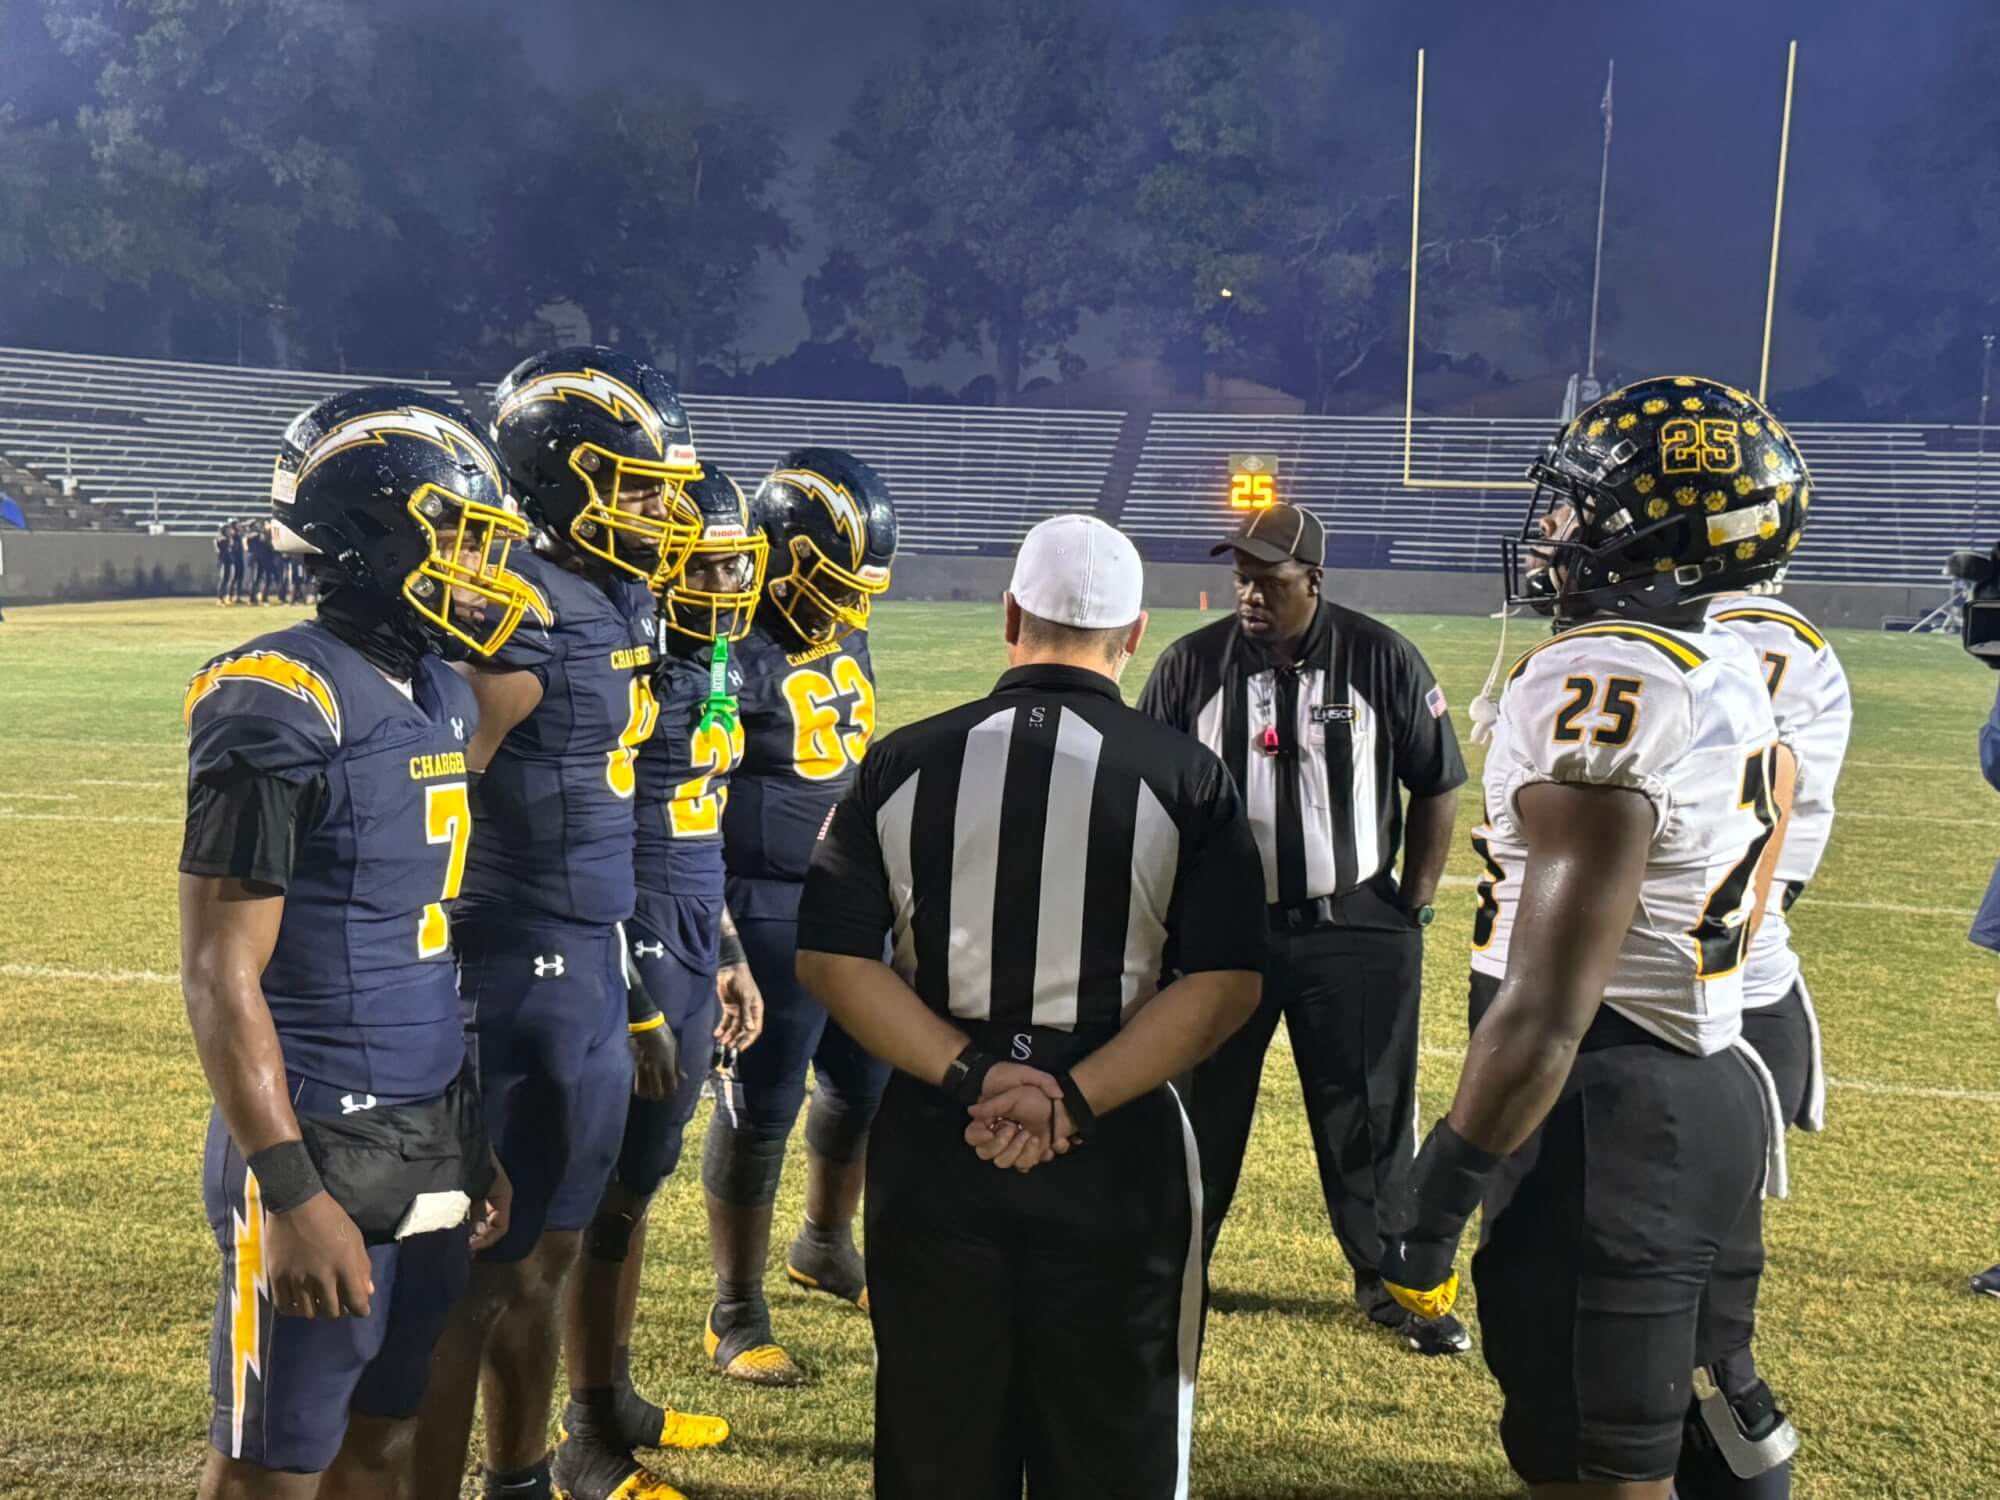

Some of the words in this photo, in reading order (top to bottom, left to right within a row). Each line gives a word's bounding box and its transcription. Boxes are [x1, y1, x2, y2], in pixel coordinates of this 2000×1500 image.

[1661, 419, 1743, 474] 25
[1231, 474, 1273, 508] 25
[782, 655, 875, 780] 63
[1552, 674, 1643, 747] 25
[418, 782, 471, 959] 7
